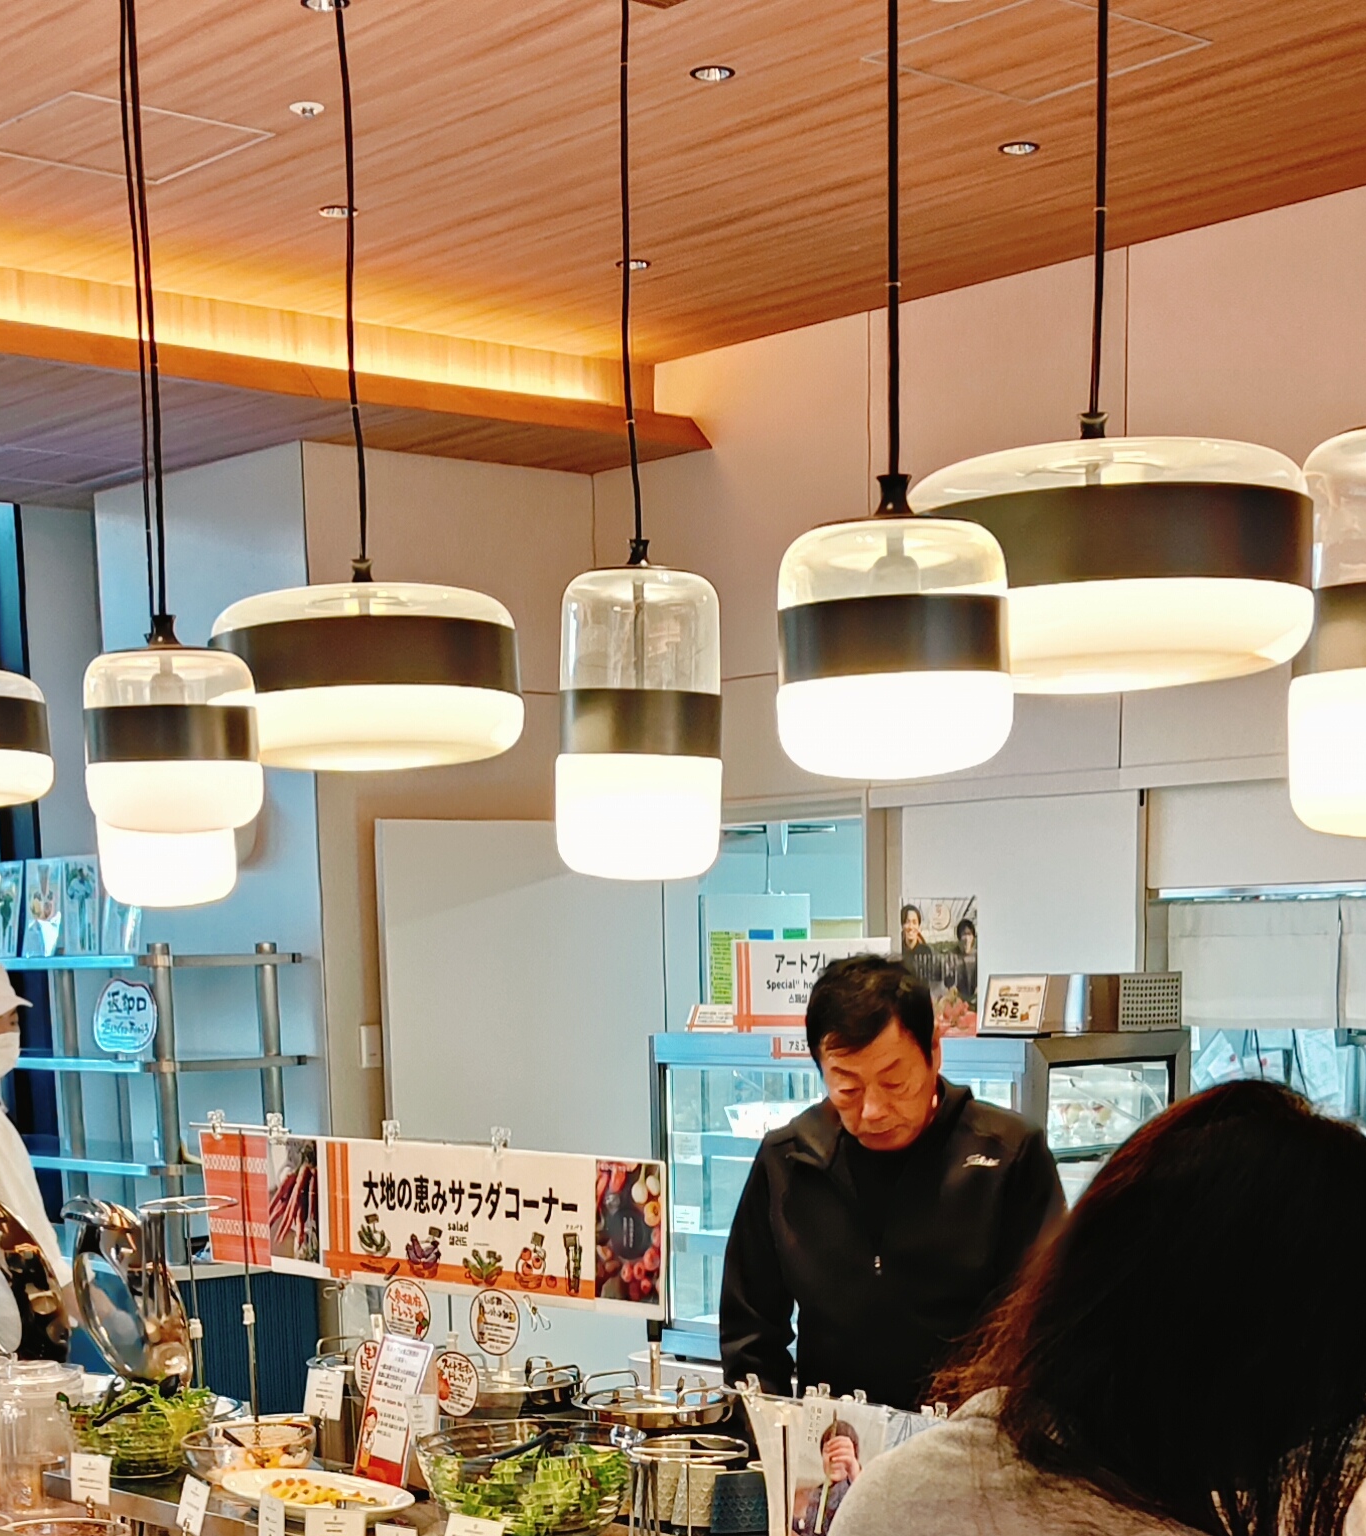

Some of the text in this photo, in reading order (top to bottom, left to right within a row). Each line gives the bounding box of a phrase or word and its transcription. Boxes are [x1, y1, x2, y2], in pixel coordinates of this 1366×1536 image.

[803, 979, 814, 990] ho
[362, 1169, 579, 1225] 大地の恵みサラダコーナー
[447, 1221, 469, 1233] salad
